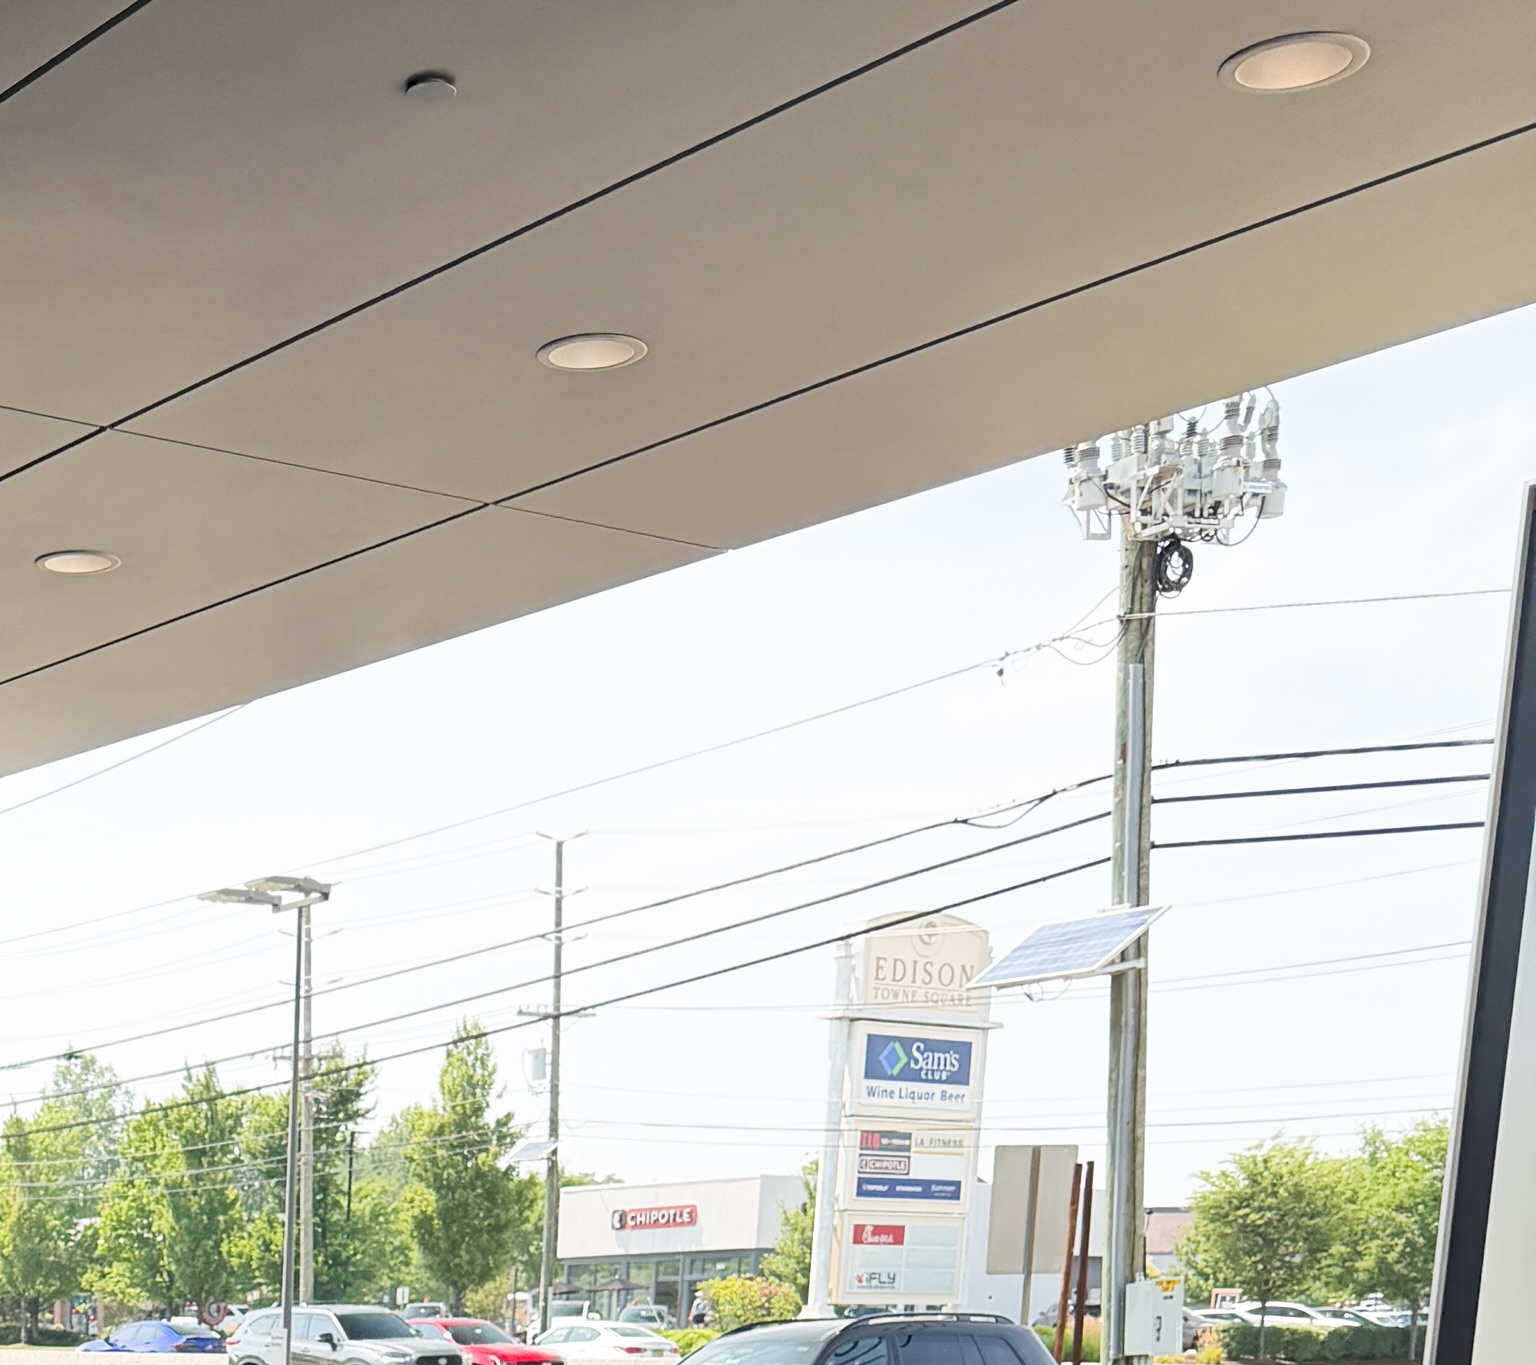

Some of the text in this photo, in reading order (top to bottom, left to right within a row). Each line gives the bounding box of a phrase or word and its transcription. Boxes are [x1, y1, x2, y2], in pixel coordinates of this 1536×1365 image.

[874, 956, 975, 988] EDISON
[873, 986, 973, 1007] TOWNE SQUARE
[910, 1041, 960, 1072] Sam's
[920, 1069, 948, 1081] CLUB
[866, 1085, 966, 1104] Wine Liquor Beer
[915, 1137, 926, 1147] LA
[929, 1138, 964, 1149] FITNESS
[627, 1208, 691, 1226] CHIPOTLE
[865, 1271, 897, 1285] iFLY
